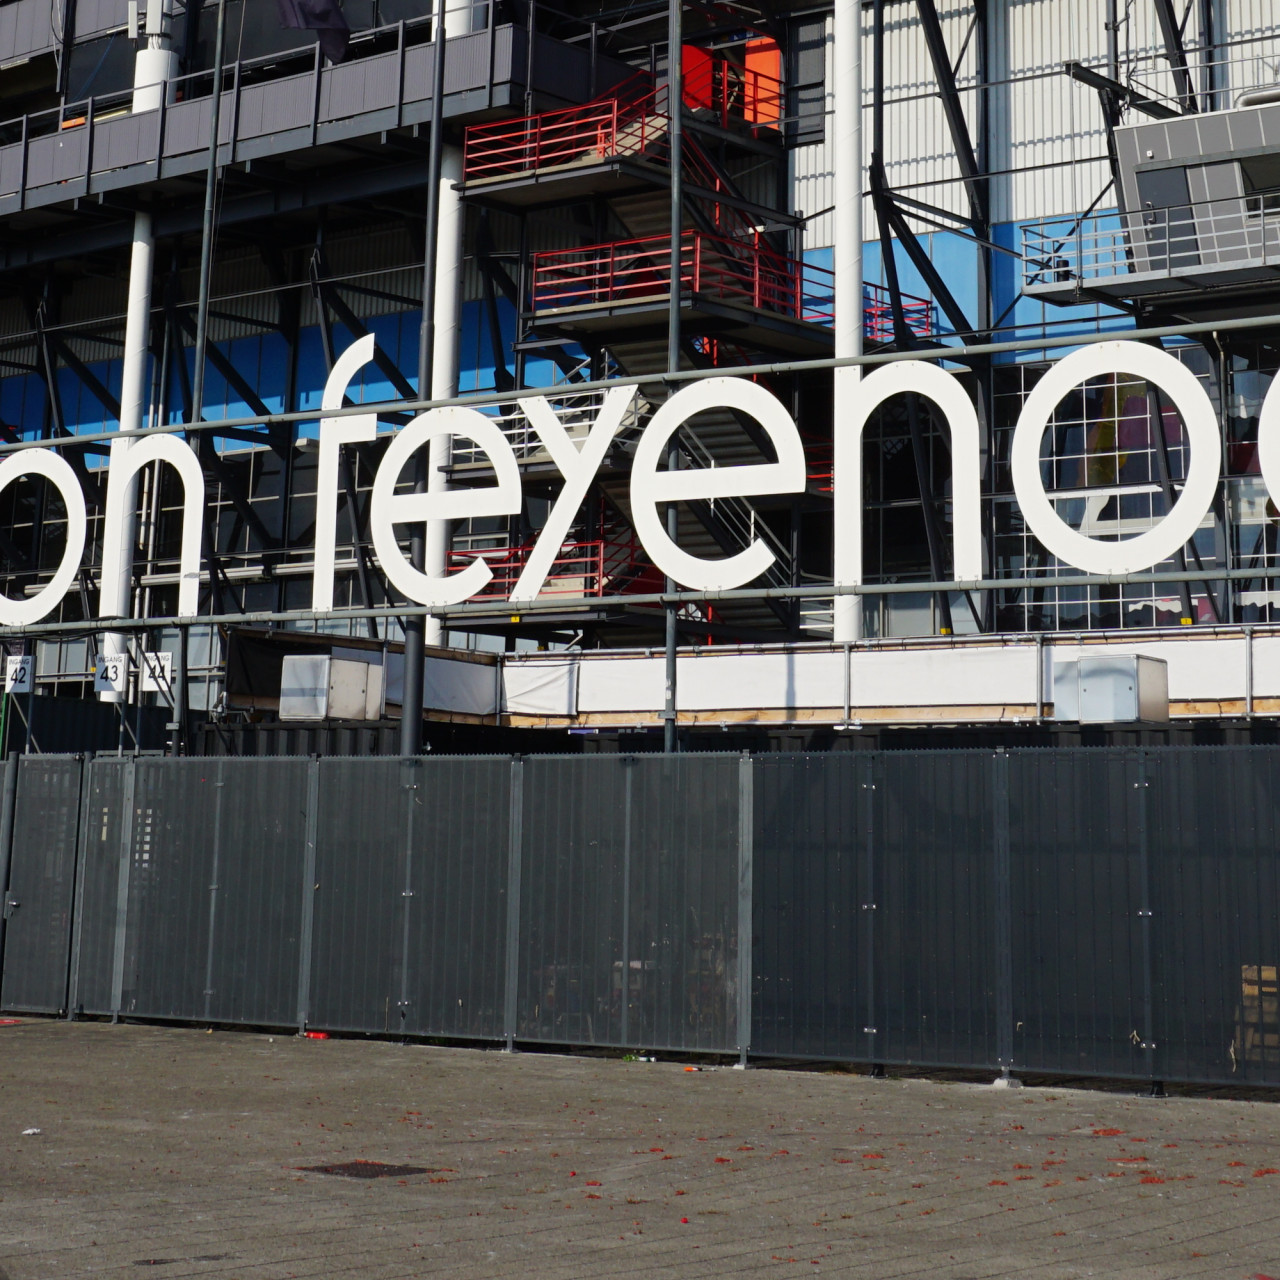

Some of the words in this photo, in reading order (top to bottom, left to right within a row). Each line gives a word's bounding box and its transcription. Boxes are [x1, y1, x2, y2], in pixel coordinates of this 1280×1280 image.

[9, 656, 30, 665] INGANG
[98, 656, 123, 664] INGANG
[10, 666, 27, 684] 42
[99, 664, 119, 682] 43
